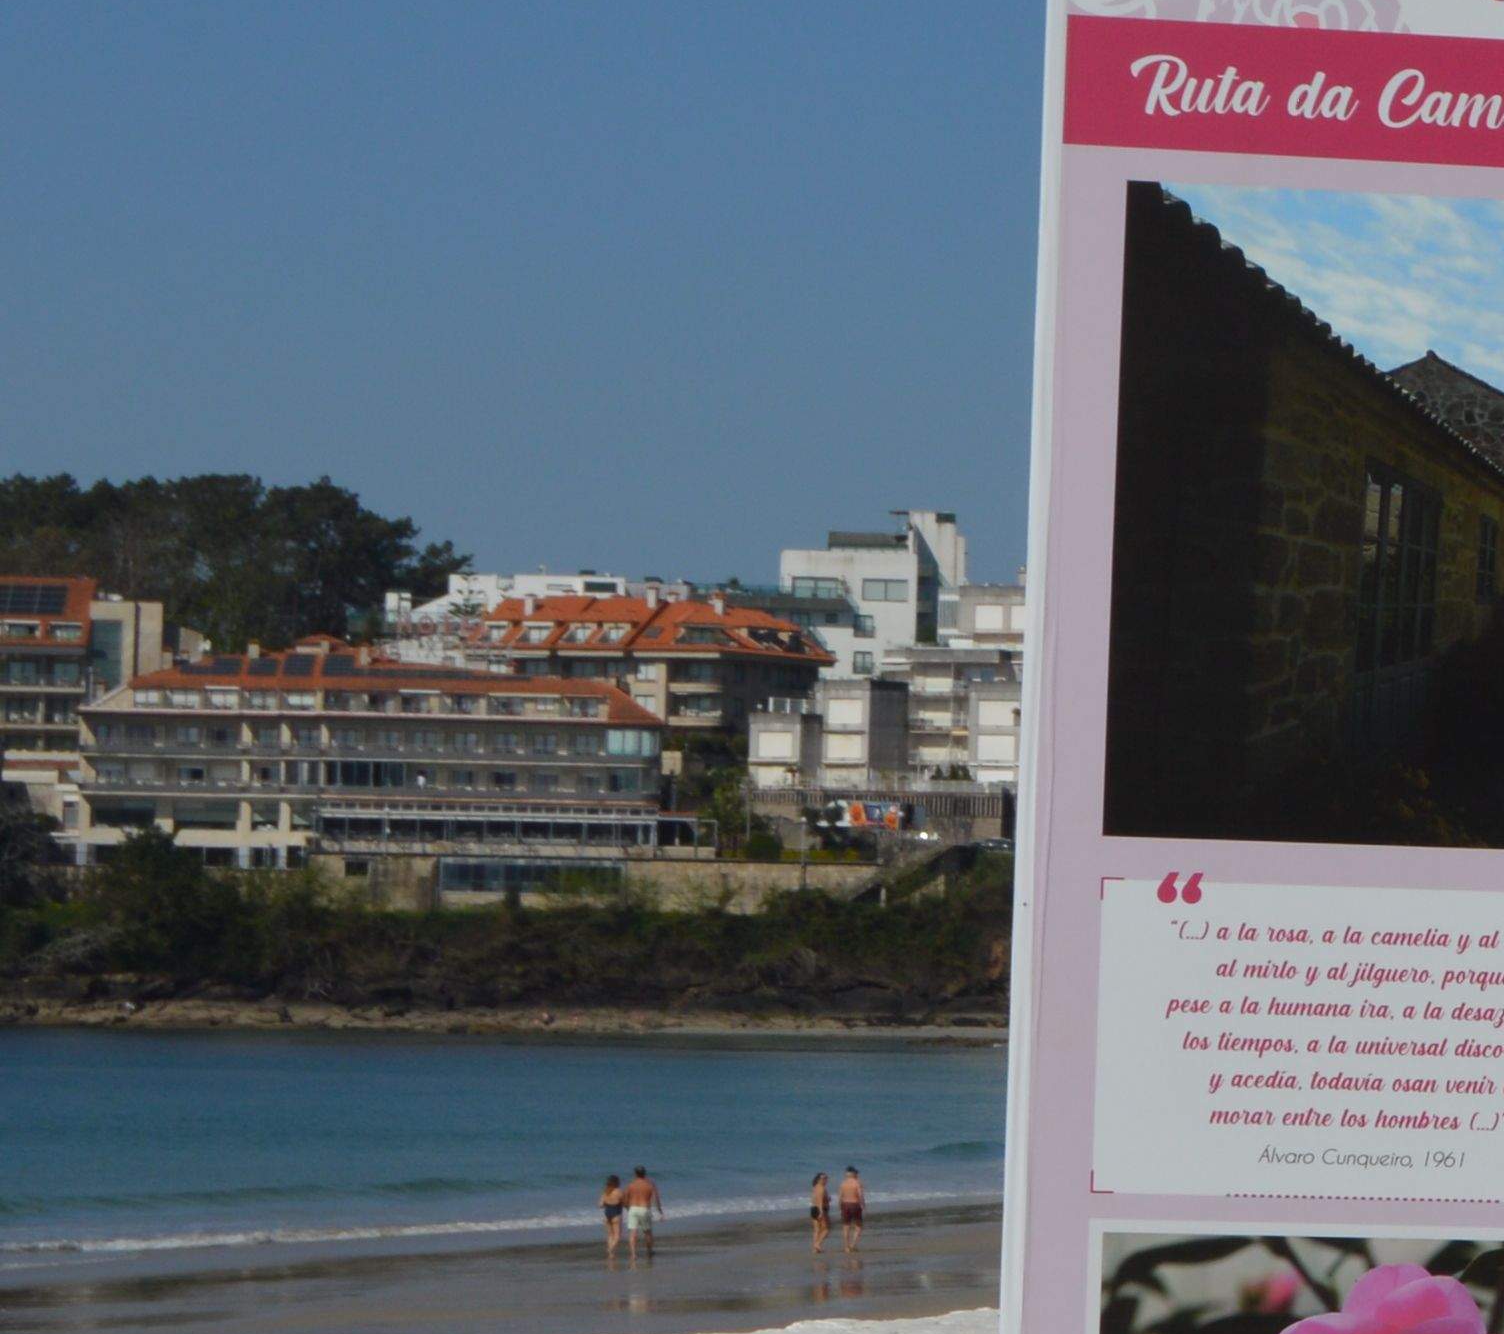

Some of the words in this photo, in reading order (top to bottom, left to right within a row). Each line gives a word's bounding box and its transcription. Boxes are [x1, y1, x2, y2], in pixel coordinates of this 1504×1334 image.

[1131, 54, 1269, 116] Ruta
[1287, 71, 1358, 121] da
[1216, 927, 1229, 940] a
[1237, 922, 1257, 941] la
[1322, 930, 1335, 944] a
[1343, 926, 1363, 945] la
[1371, 928, 1451, 947] camelia
[1457, 934, 1470, 955] y
[1478, 930, 1499, 949] al
[1216, 959, 1237, 977] al
[1243, 960, 1297, 979] mirlo
[1305, 966, 1318, 986] y
[1326, 962, 1349, 981] al
[1165, 999, 1210, 1019] pese
[1219, 1000, 1231, 1014] a
[1240, 996, 1260, 1015] la
[1267, 997, 1351, 1018] humana
[1402, 1006, 1416, 1019] a
[1423, 1001, 1444, 1020] la
[1183, 1031, 1209, 1050] los
[1307, 1039, 1319, 1053] a
[1328, 1035, 1348, 1054] la
[1355, 1037, 1448, 1056] universal
[1209, 1073, 1222, 1094] y
[1310, 1071, 1383, 1091] todavía
[1392, 1078, 1438, 1093] osan
[1446, 1076, 1495, 1094] venir
[1209, 1110, 1275, 1125] morar
[1282, 1108, 1332, 1127] entre
[1340, 1109, 1367, 1128] los
[1374, 1109, 1460, 1130] hombres
[1258, 1144, 1315, 1165] Álvaro
[1424, 1151, 1465, 1168] 1961
